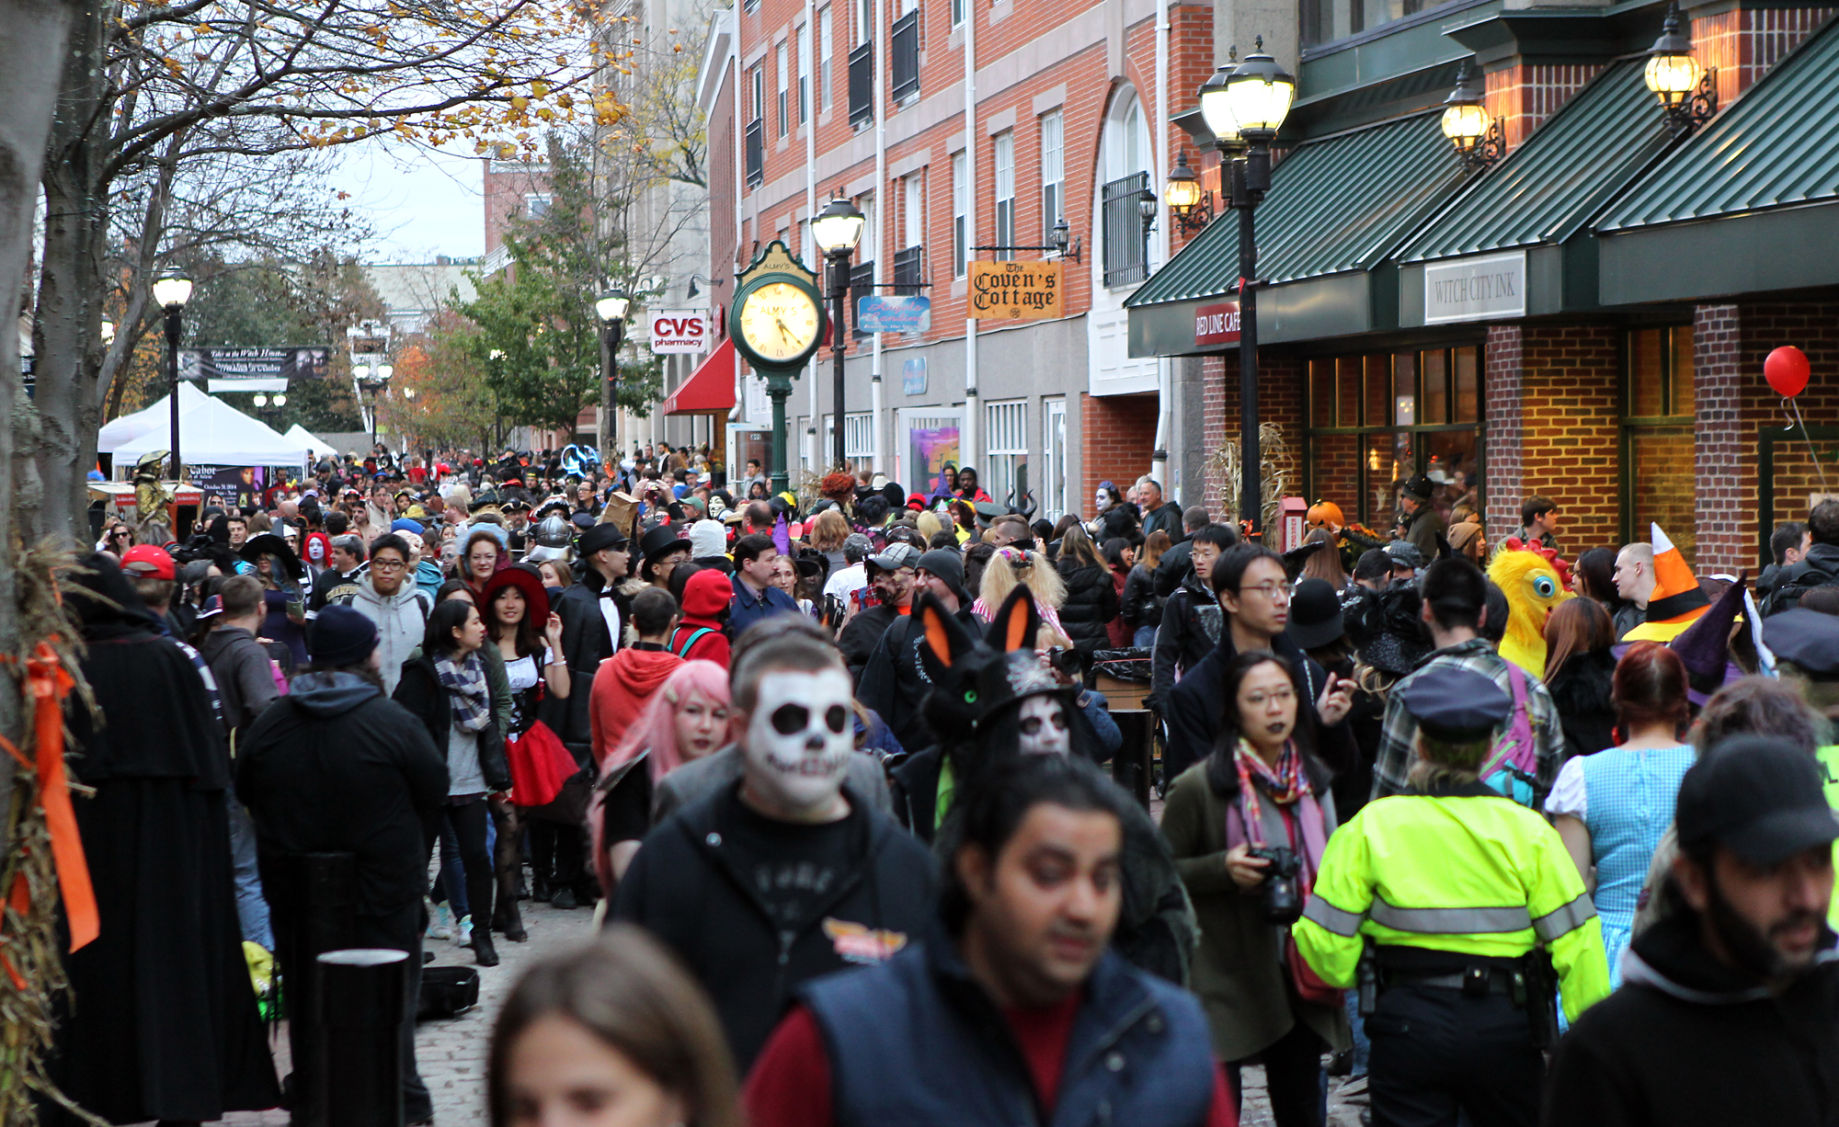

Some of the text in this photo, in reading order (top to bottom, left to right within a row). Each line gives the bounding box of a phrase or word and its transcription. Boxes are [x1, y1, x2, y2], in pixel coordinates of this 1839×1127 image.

[764, 262, 791, 270] ALMY'S
[1005, 262, 1024, 273] The
[974, 272, 1056, 292] Coven's
[1434, 271, 1516, 305] WITCH CITY INK
[974, 288, 1055, 310] Cottage
[760, 304, 799, 317] ALMYS
[654, 317, 704, 338] CVS
[1196, 315, 1208, 336] RED
[1208, 313, 1224, 335] LINE
[655, 338, 703, 348] pharmacy
[190, 464, 217, 475] Cabot
